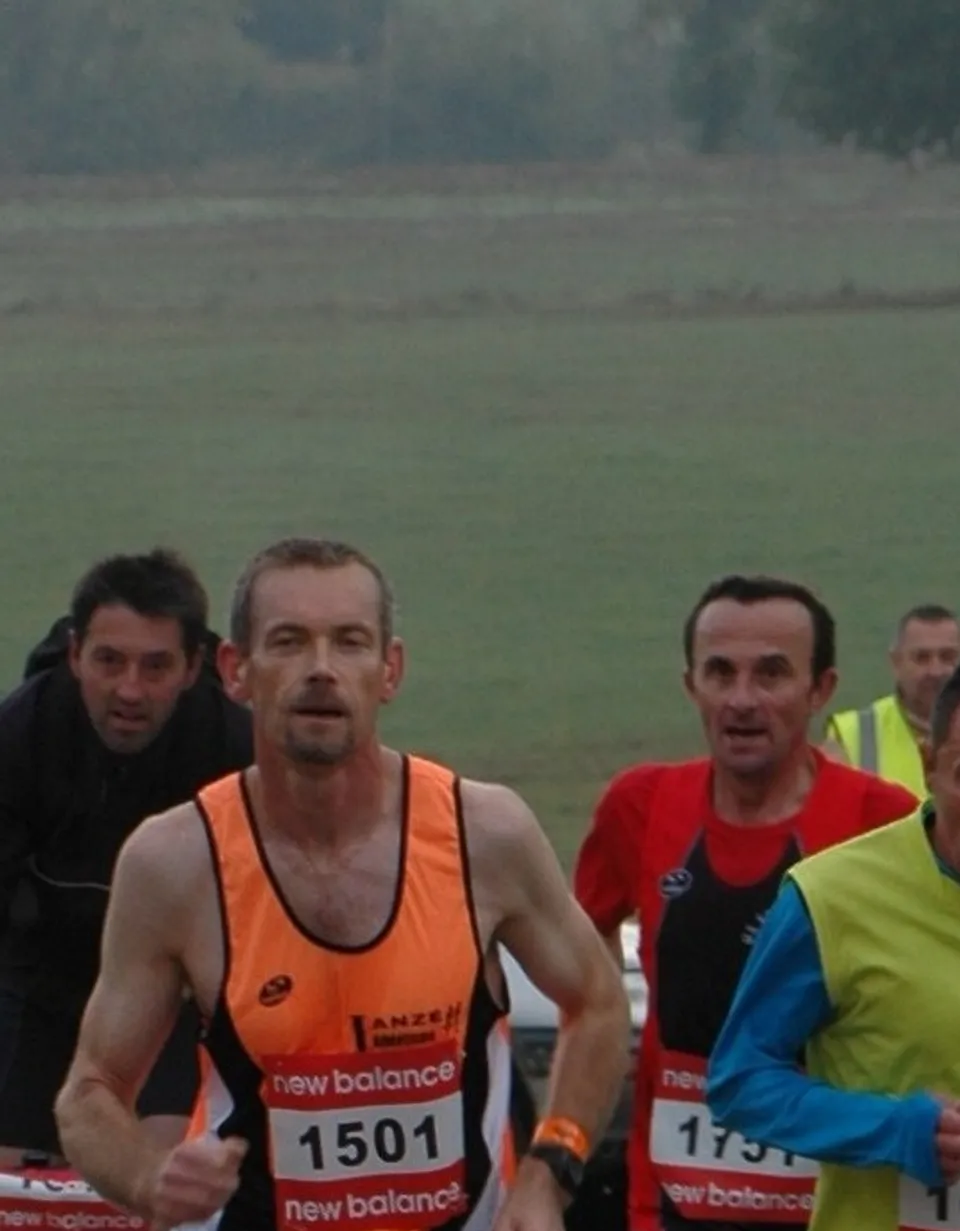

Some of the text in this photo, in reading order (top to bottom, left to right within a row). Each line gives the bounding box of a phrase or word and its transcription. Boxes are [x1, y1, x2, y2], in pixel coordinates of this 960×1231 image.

[273, 1061, 455, 1095] new balance
[299, 1115, 439, 1170] 1501
[662, 1182, 706, 1204] ew
[285, 1199, 343, 1222] new
